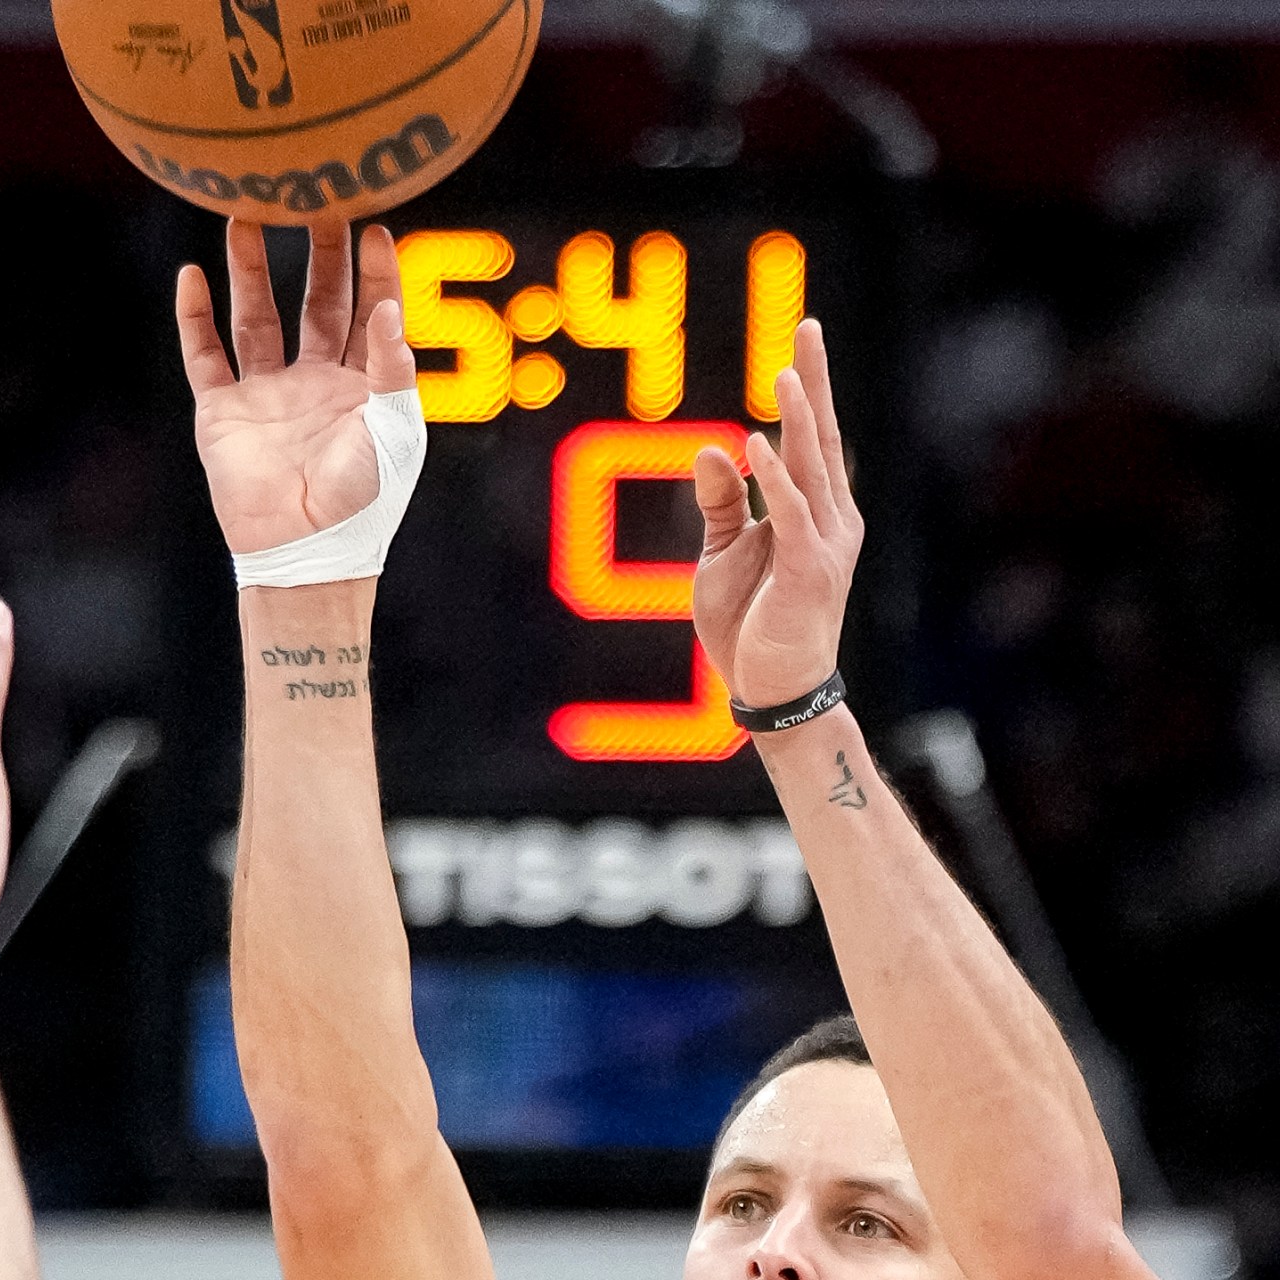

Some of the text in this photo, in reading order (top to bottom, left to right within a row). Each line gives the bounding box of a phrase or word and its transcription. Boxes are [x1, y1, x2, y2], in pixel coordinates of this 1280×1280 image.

[134, 112, 461, 213] Wilson
[396, 229, 807, 423] 5:41
[775, 708, 814, 730] ACTIVE
[384, 814, 814, 928] TISSOT
